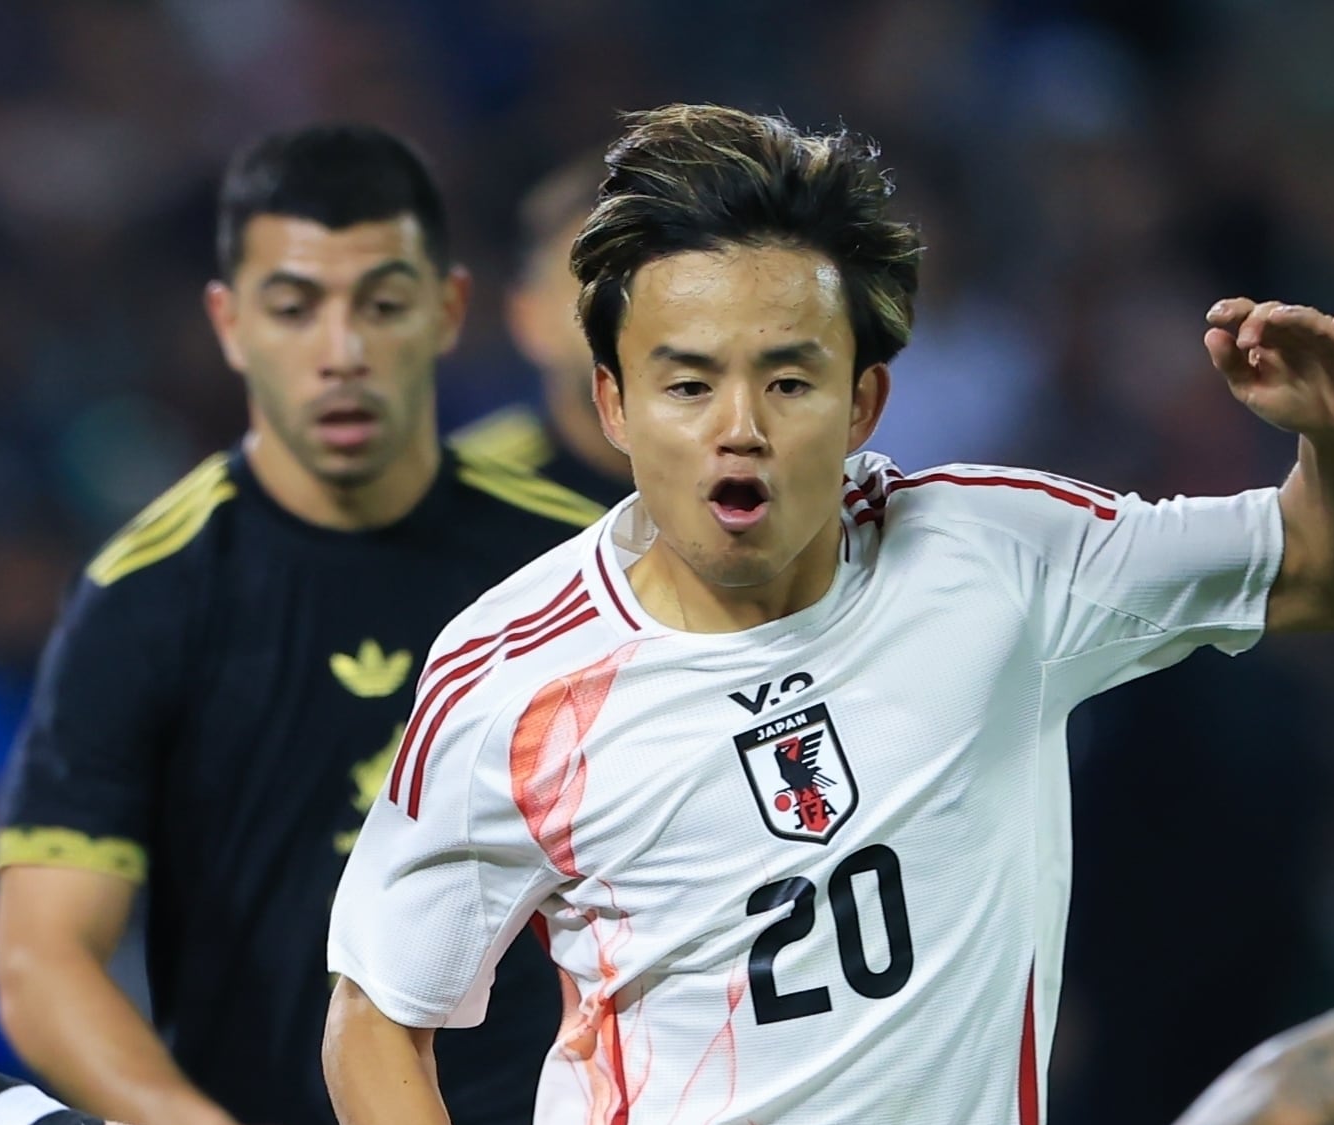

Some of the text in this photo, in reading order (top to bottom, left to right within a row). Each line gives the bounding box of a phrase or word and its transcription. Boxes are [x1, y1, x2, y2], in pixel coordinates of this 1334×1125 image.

[756, 712, 808, 741] JAPAN
[794, 799, 838, 830] JFA
[746, 844, 914, 1026] 20
